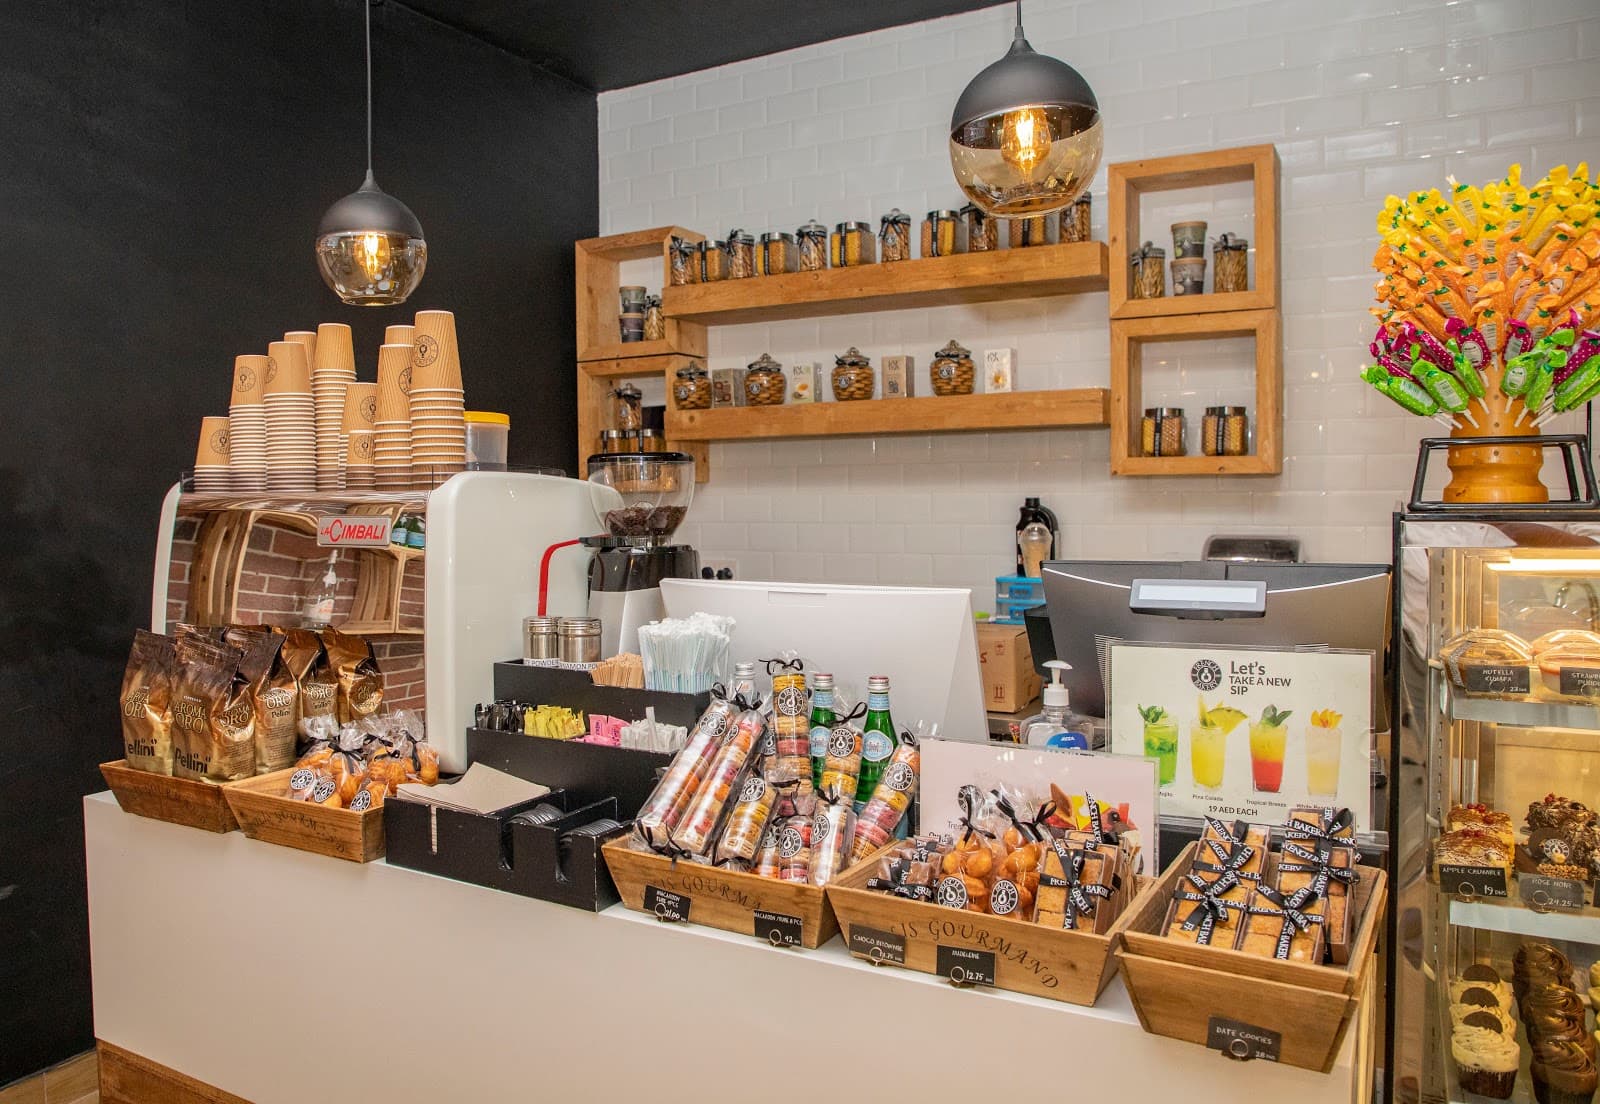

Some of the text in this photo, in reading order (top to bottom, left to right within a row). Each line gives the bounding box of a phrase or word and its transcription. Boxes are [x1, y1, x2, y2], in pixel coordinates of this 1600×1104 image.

[329, 518, 386, 543] CIMBALI
[1230, 661, 1266, 676] Let's
[1228, 675, 1292, 687] TAKE A NEW
[1230, 685, 1248, 695] SIP
[174, 701, 207, 720] AROMA
[175, 712, 204, 734] ORO
[127, 738, 157, 757] ellini
[174, 746, 212, 774] Pellini
[1208, 805, 1258, 816] 19 AED EACH
[1278, 863, 1302, 871] KERY
[1484, 884, 1494, 896] 19
[928, 920, 1060, 989] GOURMAND
[966, 969, 985, 981] 12.75
